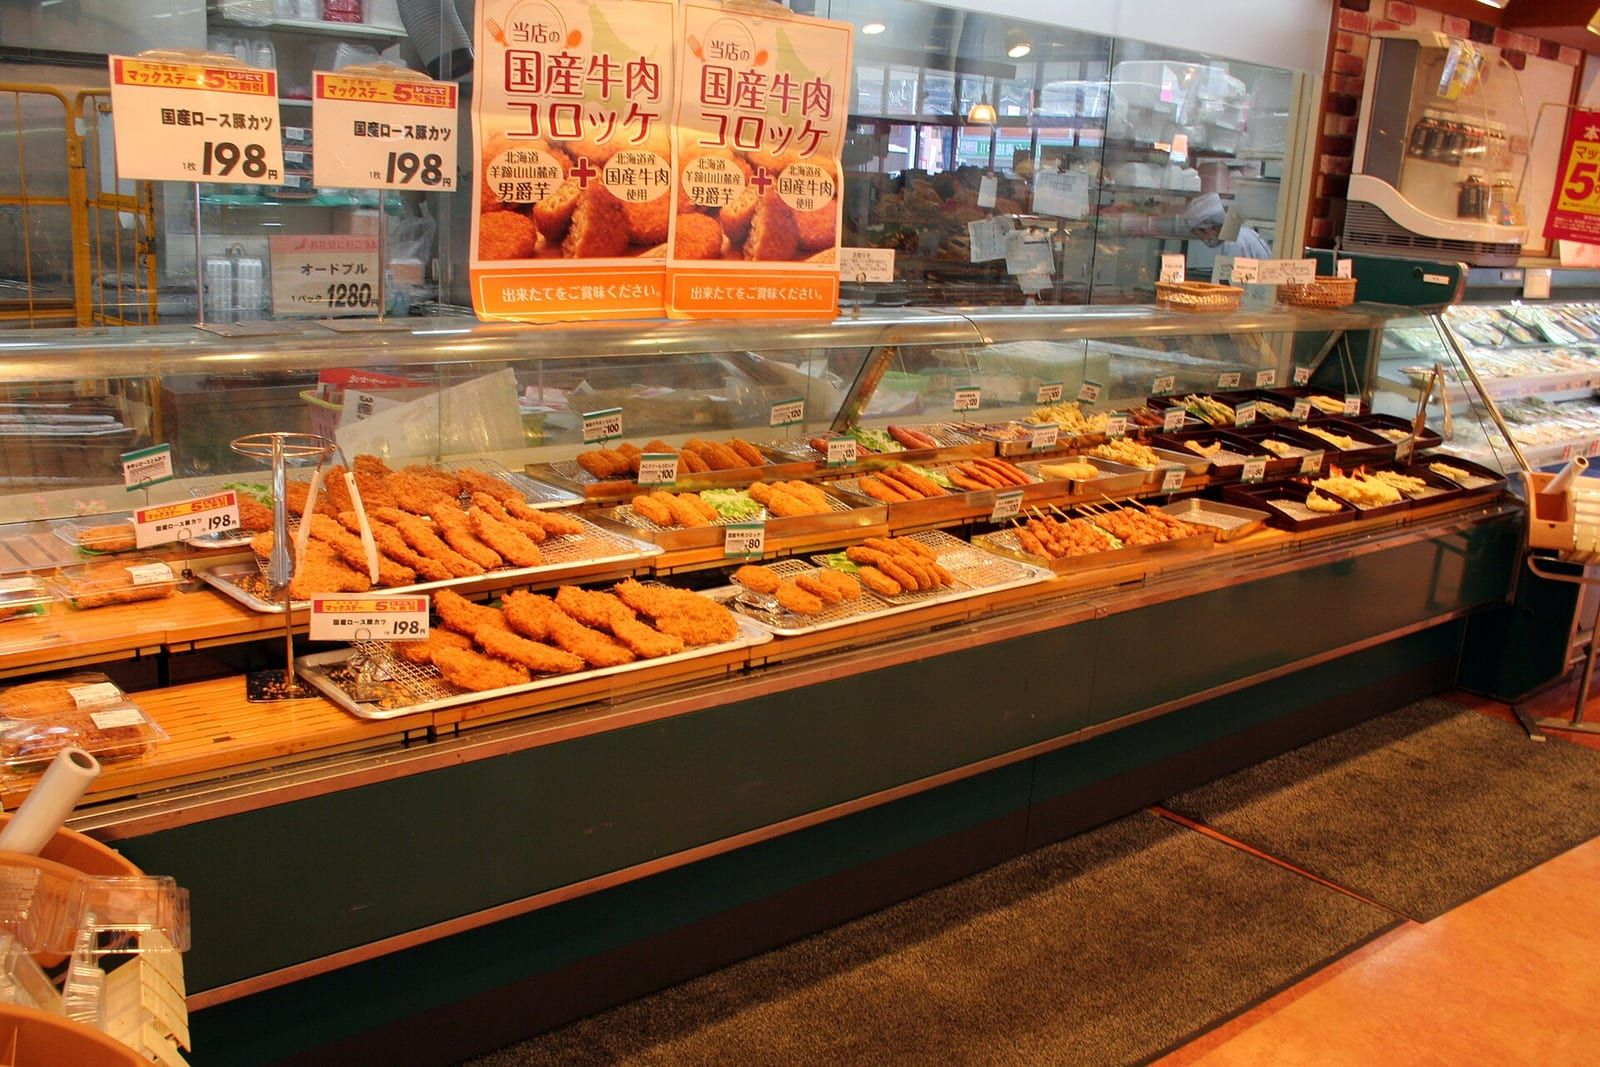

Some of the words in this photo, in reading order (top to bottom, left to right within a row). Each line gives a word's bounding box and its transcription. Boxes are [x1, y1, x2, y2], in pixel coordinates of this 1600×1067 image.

[513, 21, 560, 44] 当店の
[710, 39, 750, 62] 当店の
[128, 70, 197, 85] マックスデー
[504, 48, 659, 100] 国産牛肉
[327, 85, 388, 99] マックスデー
[700, 64, 832, 118] 国産牛肉
[161, 108, 273, 131] 国産ロース豚カツ
[506, 102, 659, 142] コロッケ
[353, 121, 452, 142] 国産ロース豚カツ
[699, 112, 829, 157] コロッケ
[504, 151, 539, 164] 北海道
[615, 151, 657, 165] 北海道産
[696, 159, 726, 170] 北海道
[604, 168, 670, 186] 国産牛肉
[787, 165, 822, 177] 北海道産
[497, 182, 551, 201] 男爵芋
[625, 189, 648, 201] 使用
[691, 187, 734, 205] 男爵芋
[779, 178, 833, 197] 国産牛肉
[795, 198, 814, 210] 使用
[300, 263, 368, 276] オードブル
